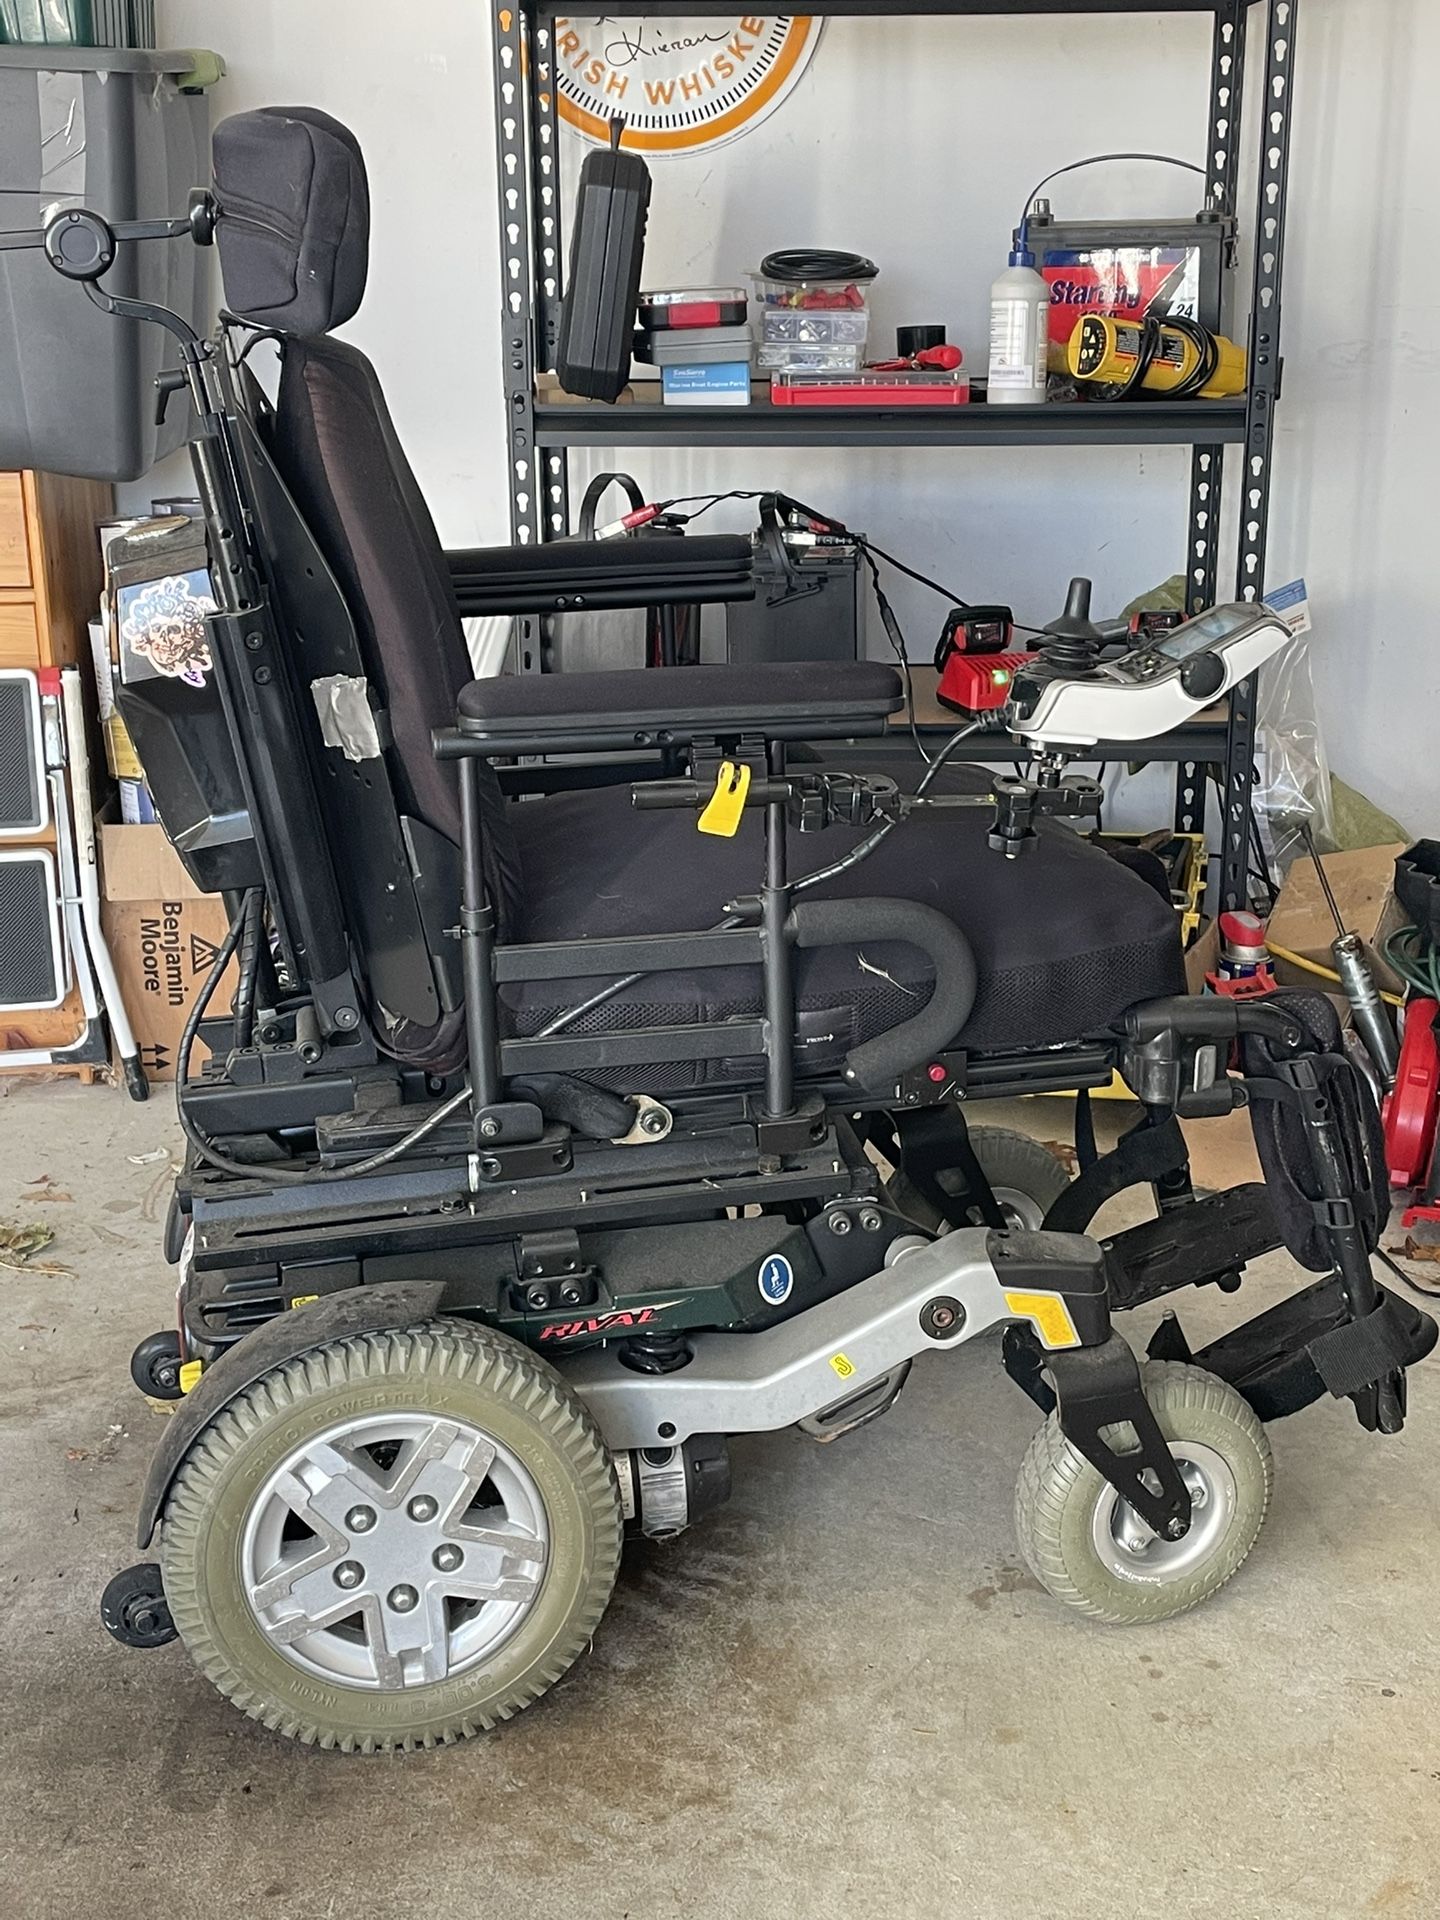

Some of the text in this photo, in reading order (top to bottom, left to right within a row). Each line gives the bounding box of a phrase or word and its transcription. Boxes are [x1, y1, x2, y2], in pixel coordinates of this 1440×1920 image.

[1050, 280, 1141, 309] Startng
[140, 919, 162, 992] Moore
[159, 902, 189, 1006] Benjamin
[540, 1308, 661, 1339] RIVAL
